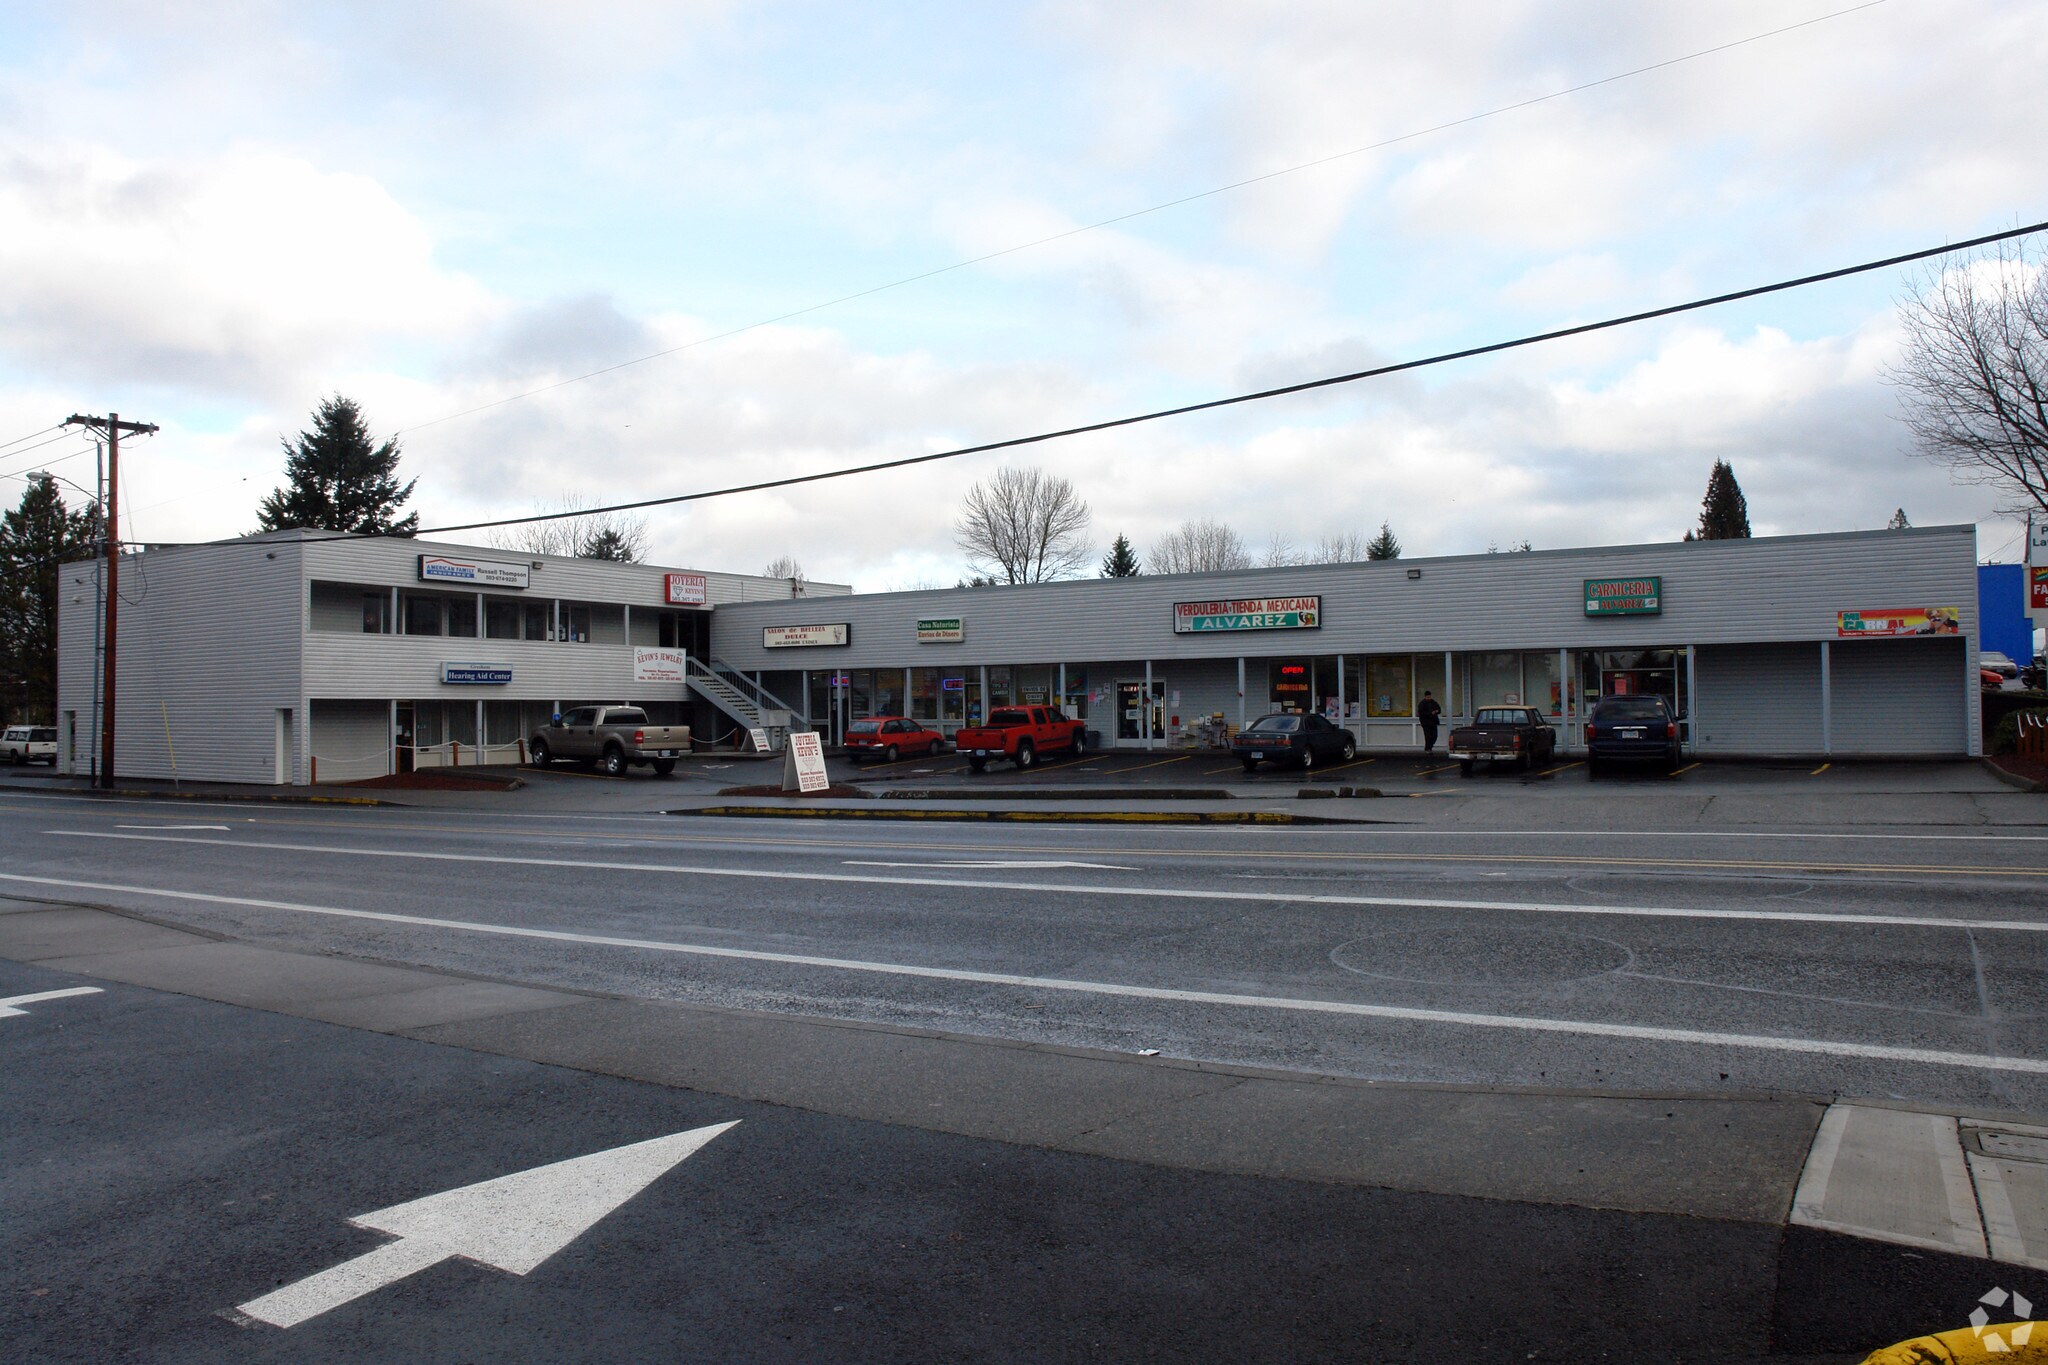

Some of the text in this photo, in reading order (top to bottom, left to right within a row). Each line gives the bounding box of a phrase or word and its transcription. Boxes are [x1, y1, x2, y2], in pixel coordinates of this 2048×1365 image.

[426, 564, 474, 574] AMERICAN FAMILY
[499, 570, 527, 578] Thompson
[670, 576, 703, 587] JOYERIA
[1589, 581, 1654, 597] CARNICERIA
[1176, 603, 1229, 617] VERDULERIA
[1231, 601, 1263, 613] TIENDA
[1266, 598, 1316, 613] MEXICANA
[1601, 599, 1643, 609] ALVAREZ
[1201, 614, 1287, 629] ALVAREZ
[1843, 612, 1860, 621] MI
[918, 621, 959, 629] Casa Naturista
[1843, 619, 1906, 630] CARNAL
[637, 653, 683, 665] KEVIN'S JEWELRY
[1282, 666, 1304, 674] OPEN
[448, 672, 511, 680] Hearing Aid Center
[795, 734, 817, 746] JOYERIA
[797, 746, 819, 757] KEVIN'S
